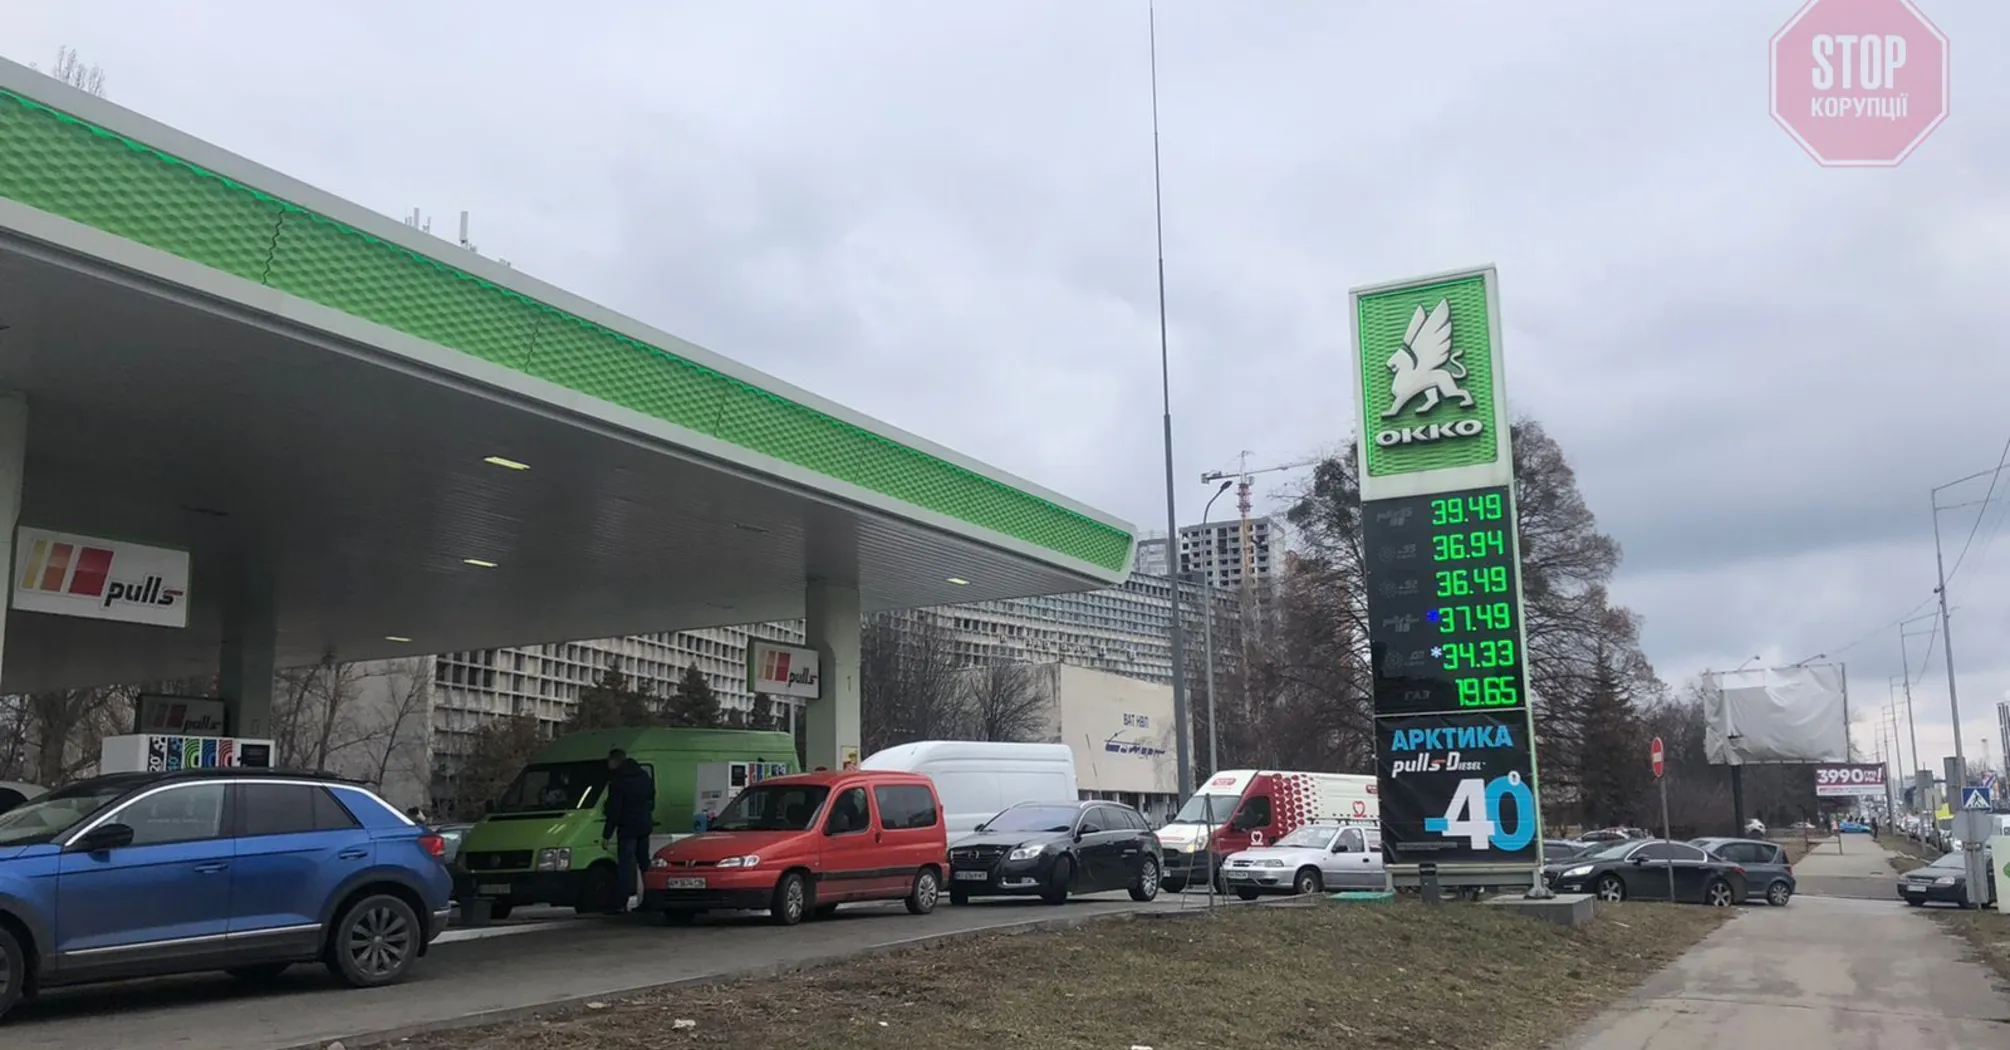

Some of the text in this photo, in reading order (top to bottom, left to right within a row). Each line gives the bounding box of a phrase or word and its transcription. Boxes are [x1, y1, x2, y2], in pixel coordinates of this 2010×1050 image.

[1375, 419, 1484, 446] OKKO
[1431, 493, 1502, 525] 39.49
[1432, 529, 1504, 561] 36.94
[103, 575, 184, 608] pulls
[1435, 566, 1508, 597] 36.49
[1438, 602, 1511, 633] 37.49
[788, 668, 817, 687] pulls
[1455, 676, 1517, 706] 19.65
[1391, 725, 1513, 751] АРКТИКА
[1391, 752, 1447, 779] pulls
[1816, 768, 1864, 784] 3990
